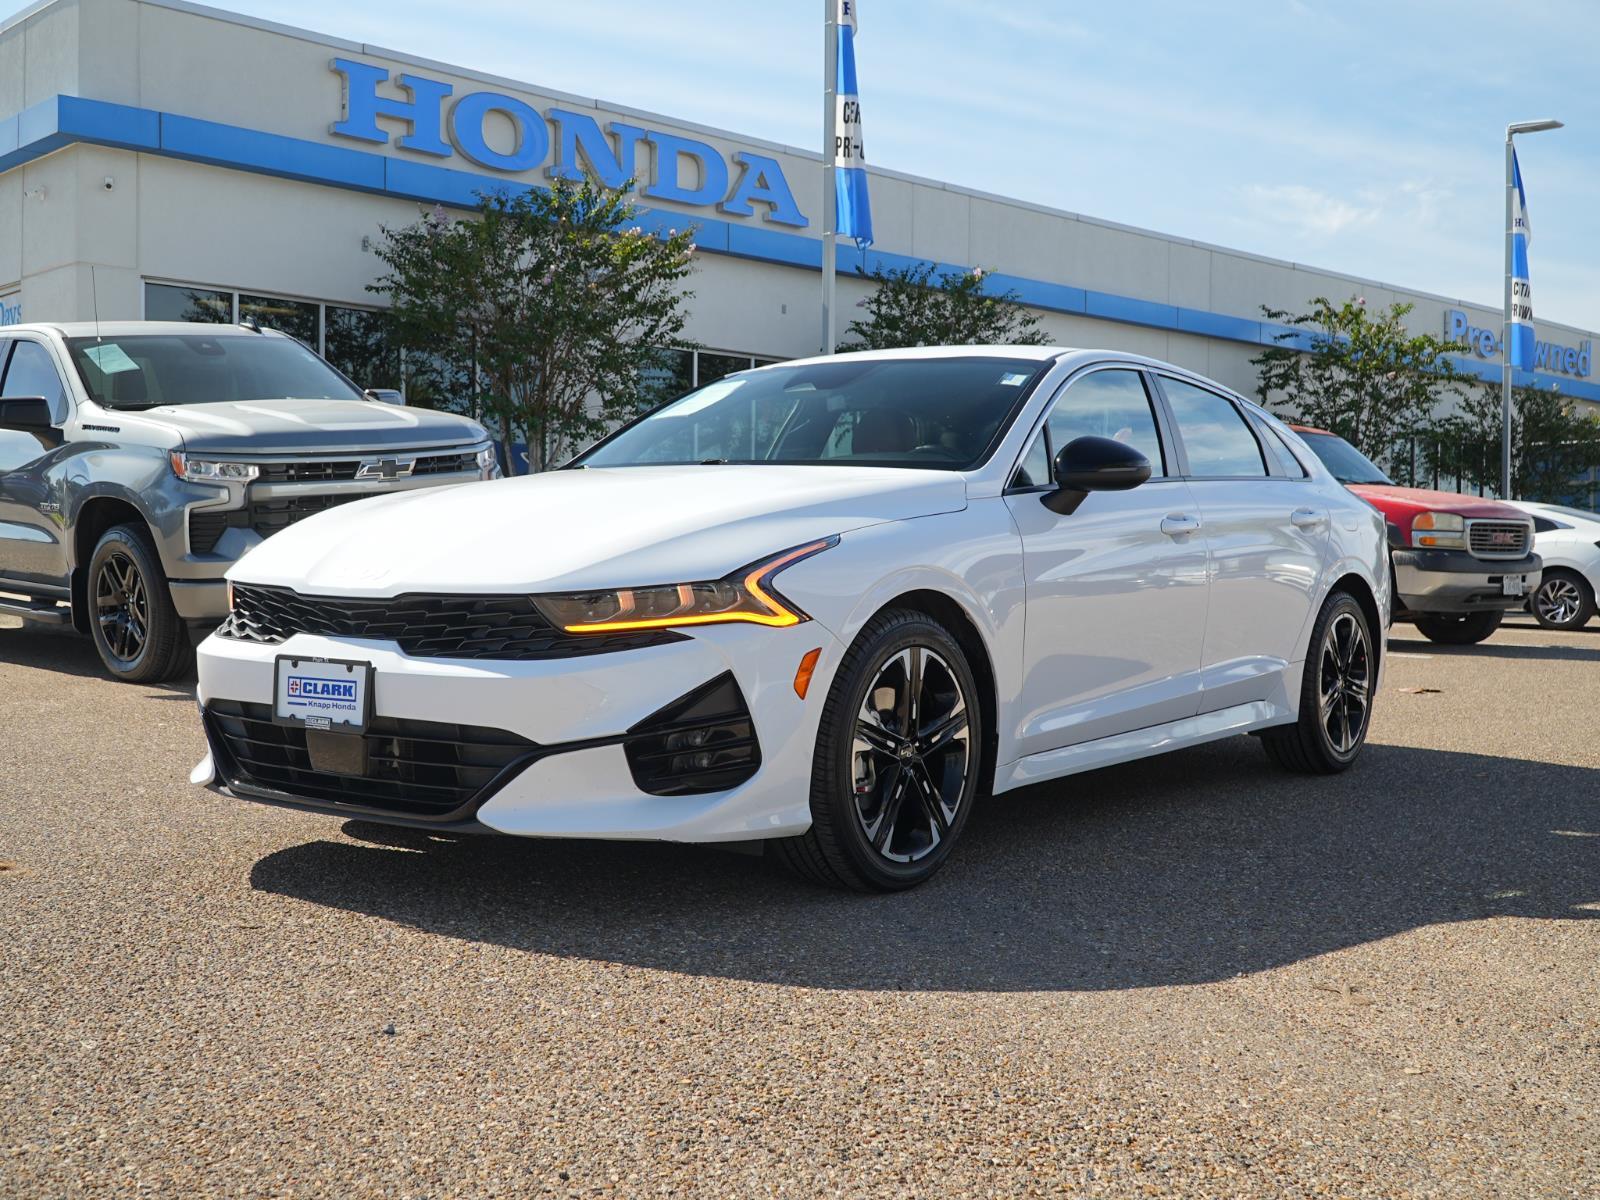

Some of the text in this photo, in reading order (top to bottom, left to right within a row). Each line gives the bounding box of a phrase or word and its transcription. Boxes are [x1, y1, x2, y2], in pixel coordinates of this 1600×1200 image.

[329, 57, 808, 228] HONDA
[1444, 309, 1592, 377] Pre-wned
[302, 681, 353, 698] CLARK
[308, 700, 357, 711] Knapp Honda
